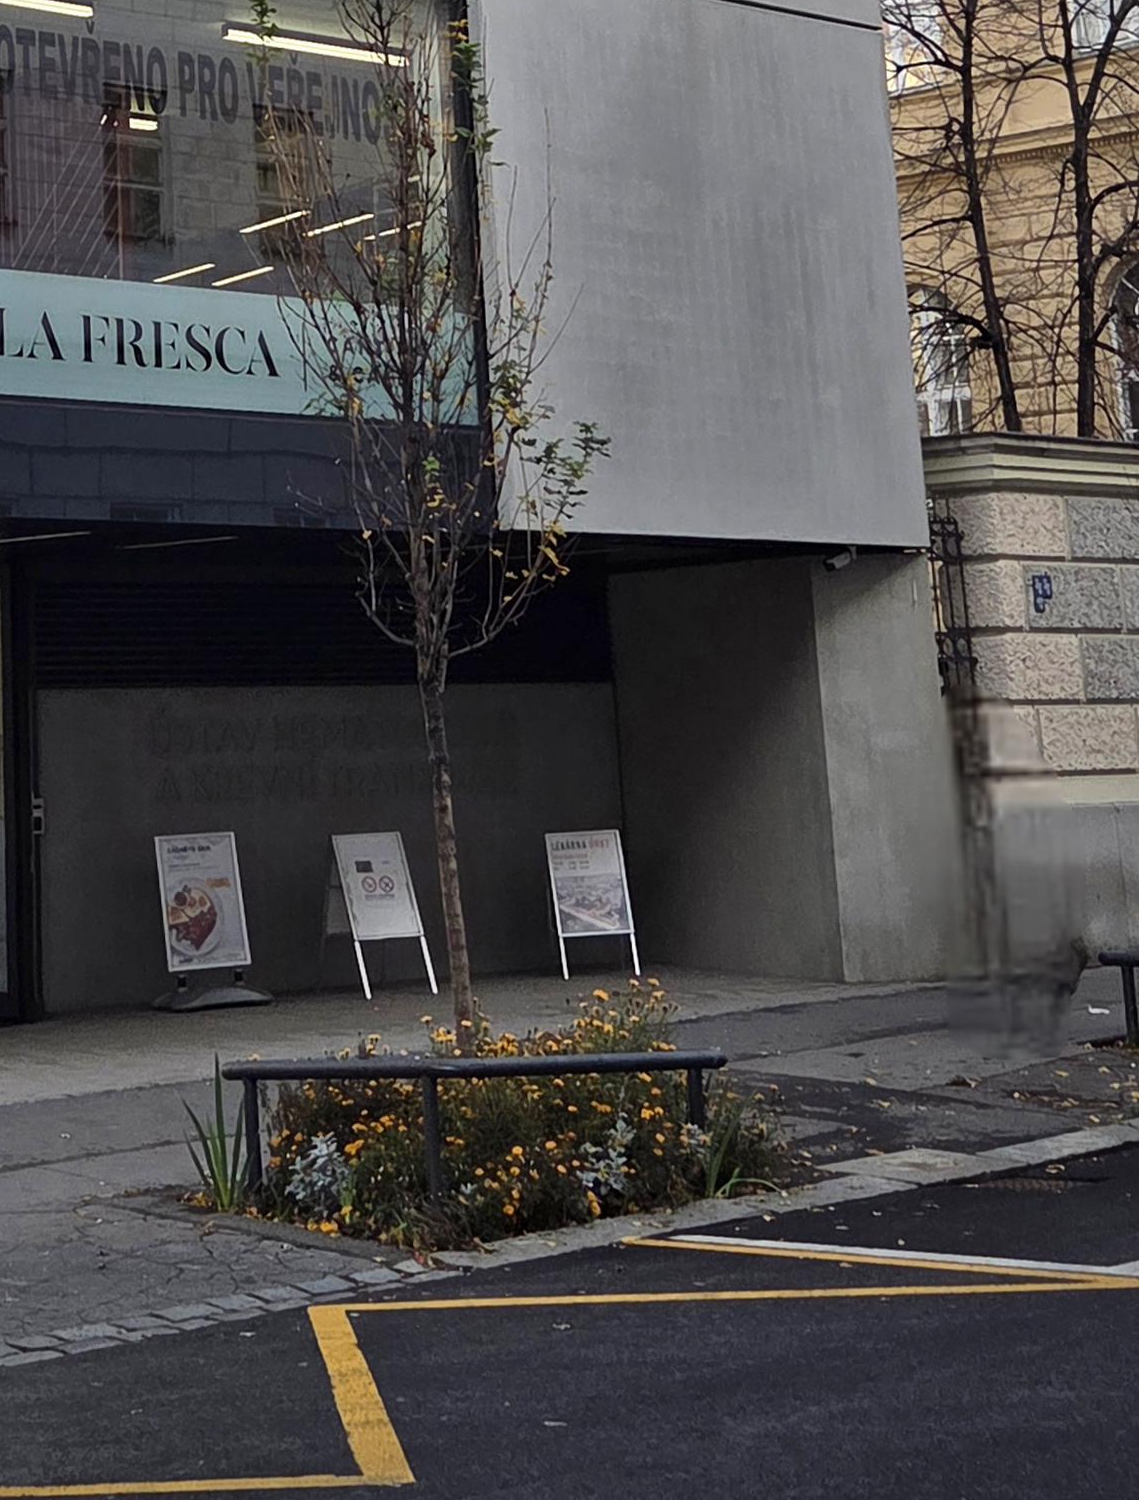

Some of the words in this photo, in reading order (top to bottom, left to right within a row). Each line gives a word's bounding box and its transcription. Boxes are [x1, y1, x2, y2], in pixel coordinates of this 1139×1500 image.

[177, 51, 239, 125] PRO
[245, 53, 418, 151] VEŘEJNO
[80, 313, 282, 378] FRESCA
